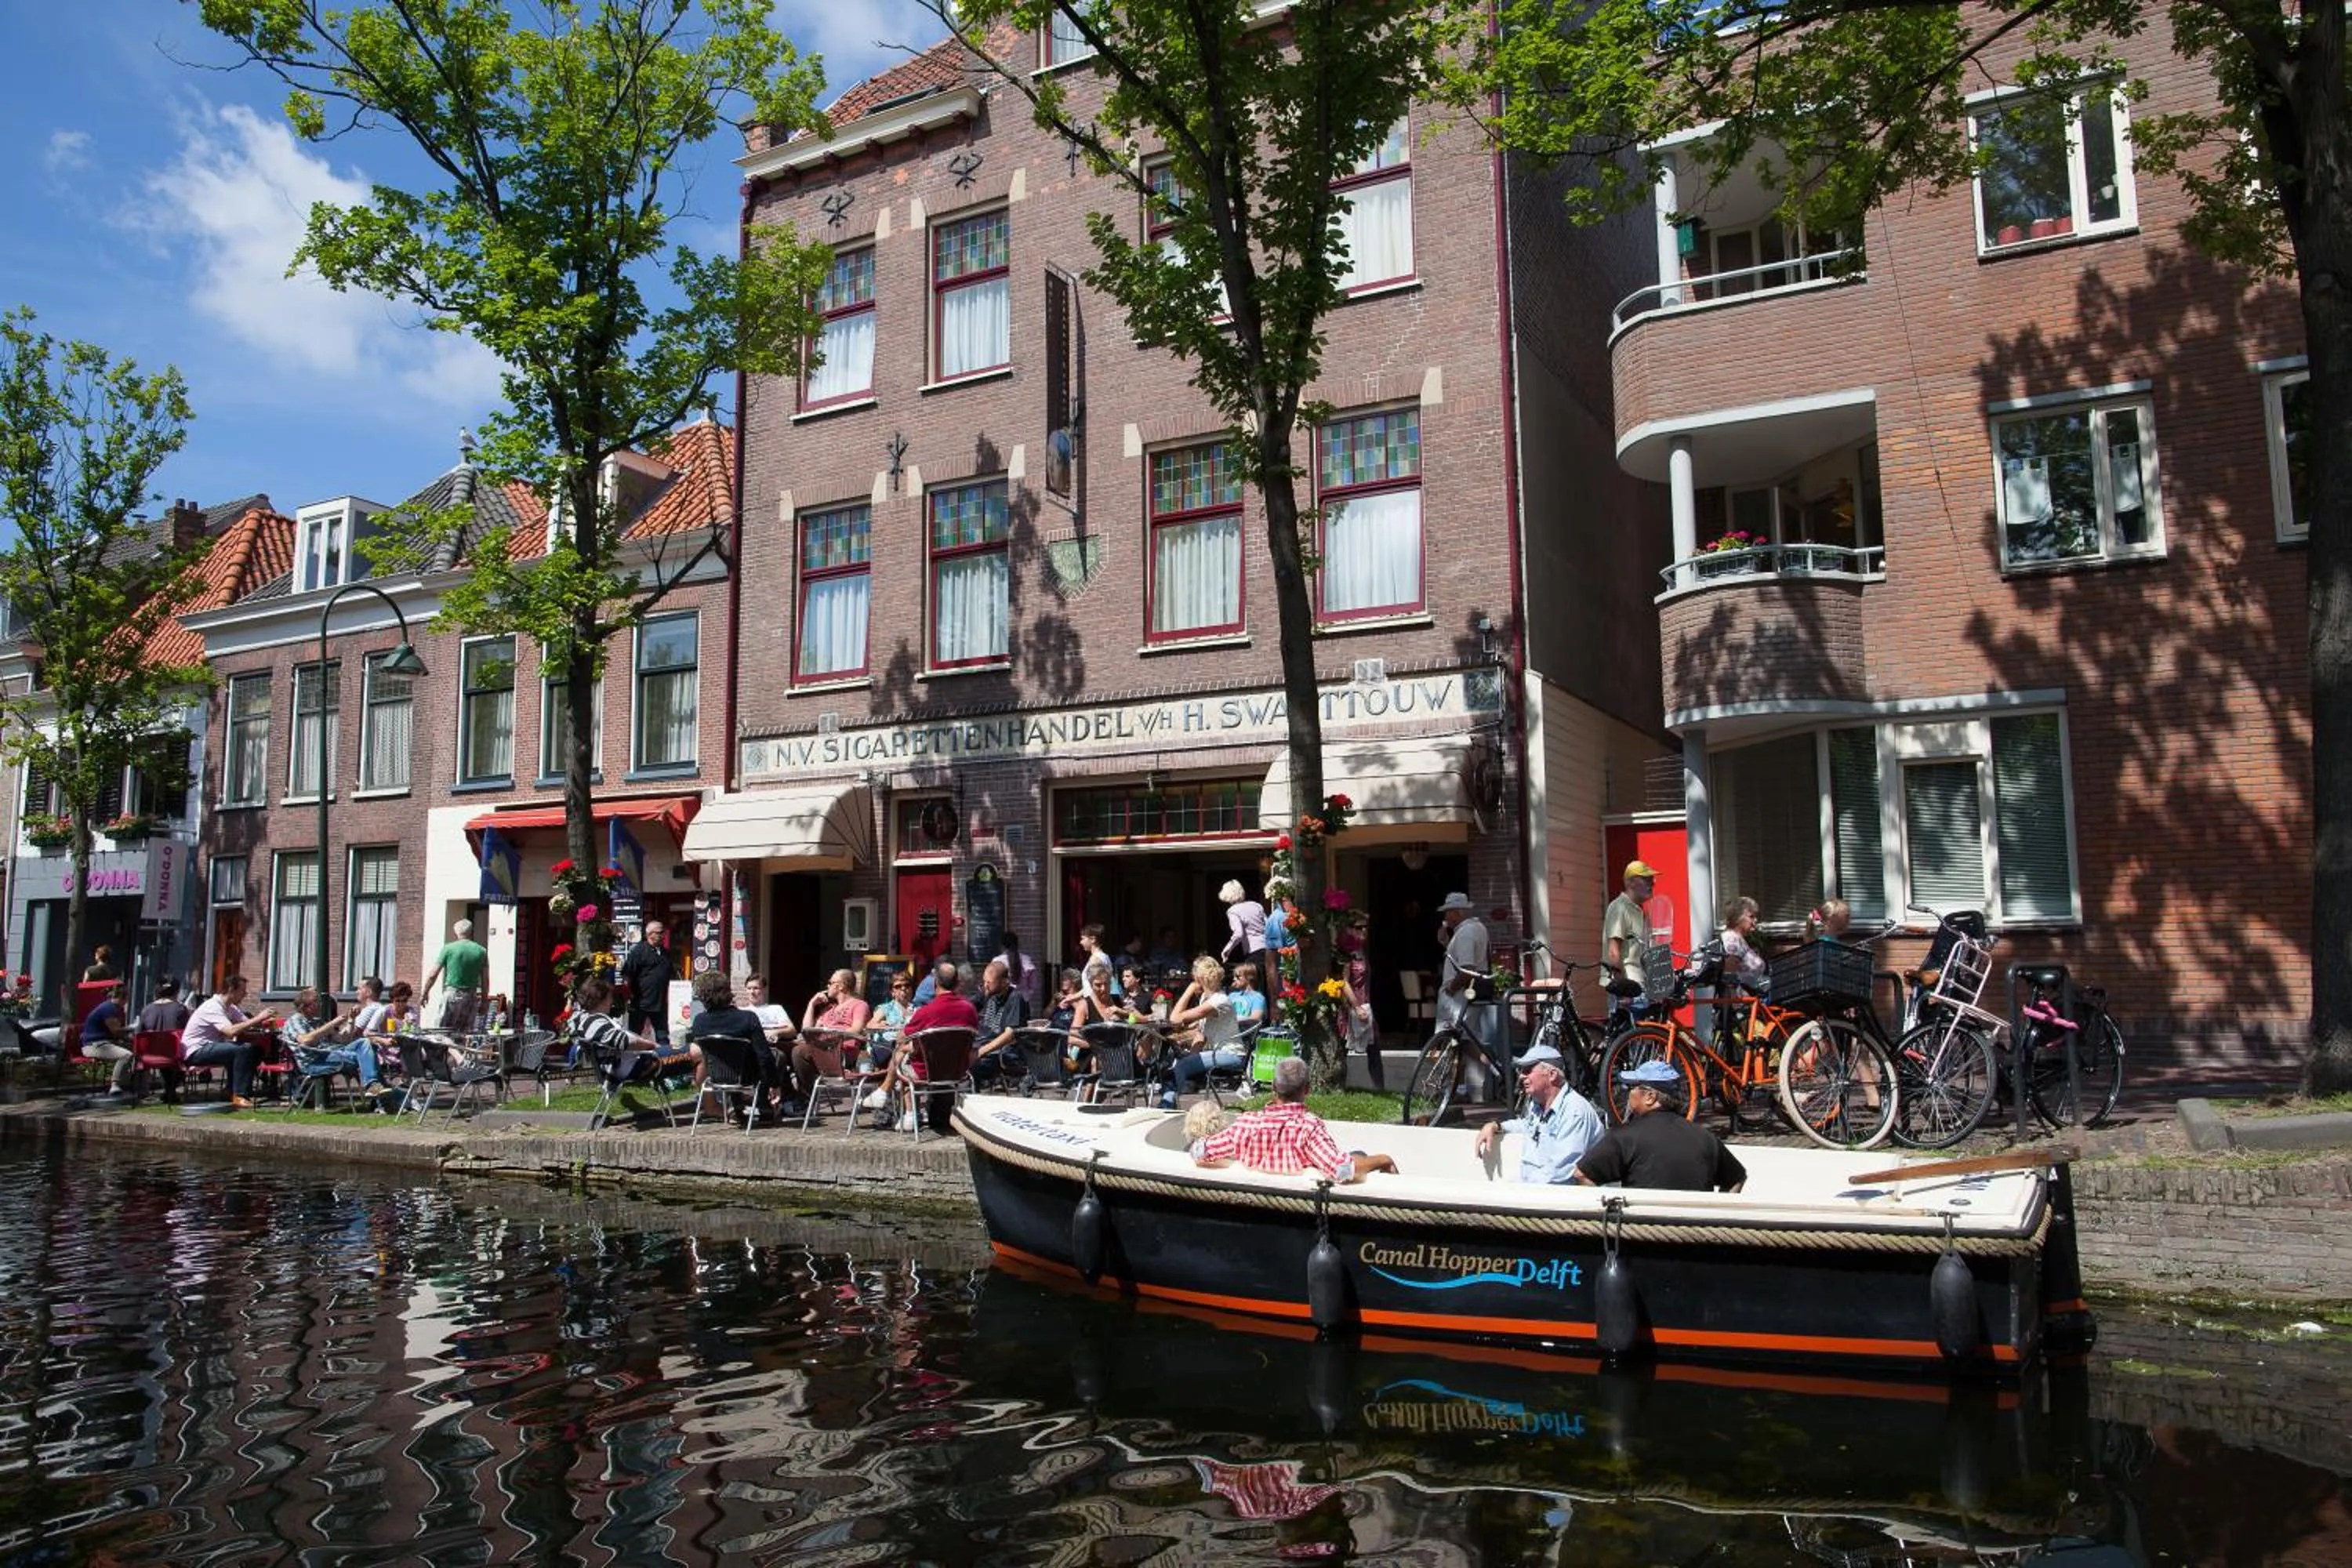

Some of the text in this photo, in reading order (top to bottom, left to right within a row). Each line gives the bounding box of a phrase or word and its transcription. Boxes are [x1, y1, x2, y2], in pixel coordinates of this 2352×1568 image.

[776, 739, 815, 768] N.V.
[822, 709, 1134, 764] SIGARETTENHANDEL
[1182, 702, 1210, 731] H.
[1220, 679, 1453, 729] SWATTOUW
[158, 846, 173, 912] O'DONNA
[1359, 1241, 1583, 1290] Canal Hopper Delft
